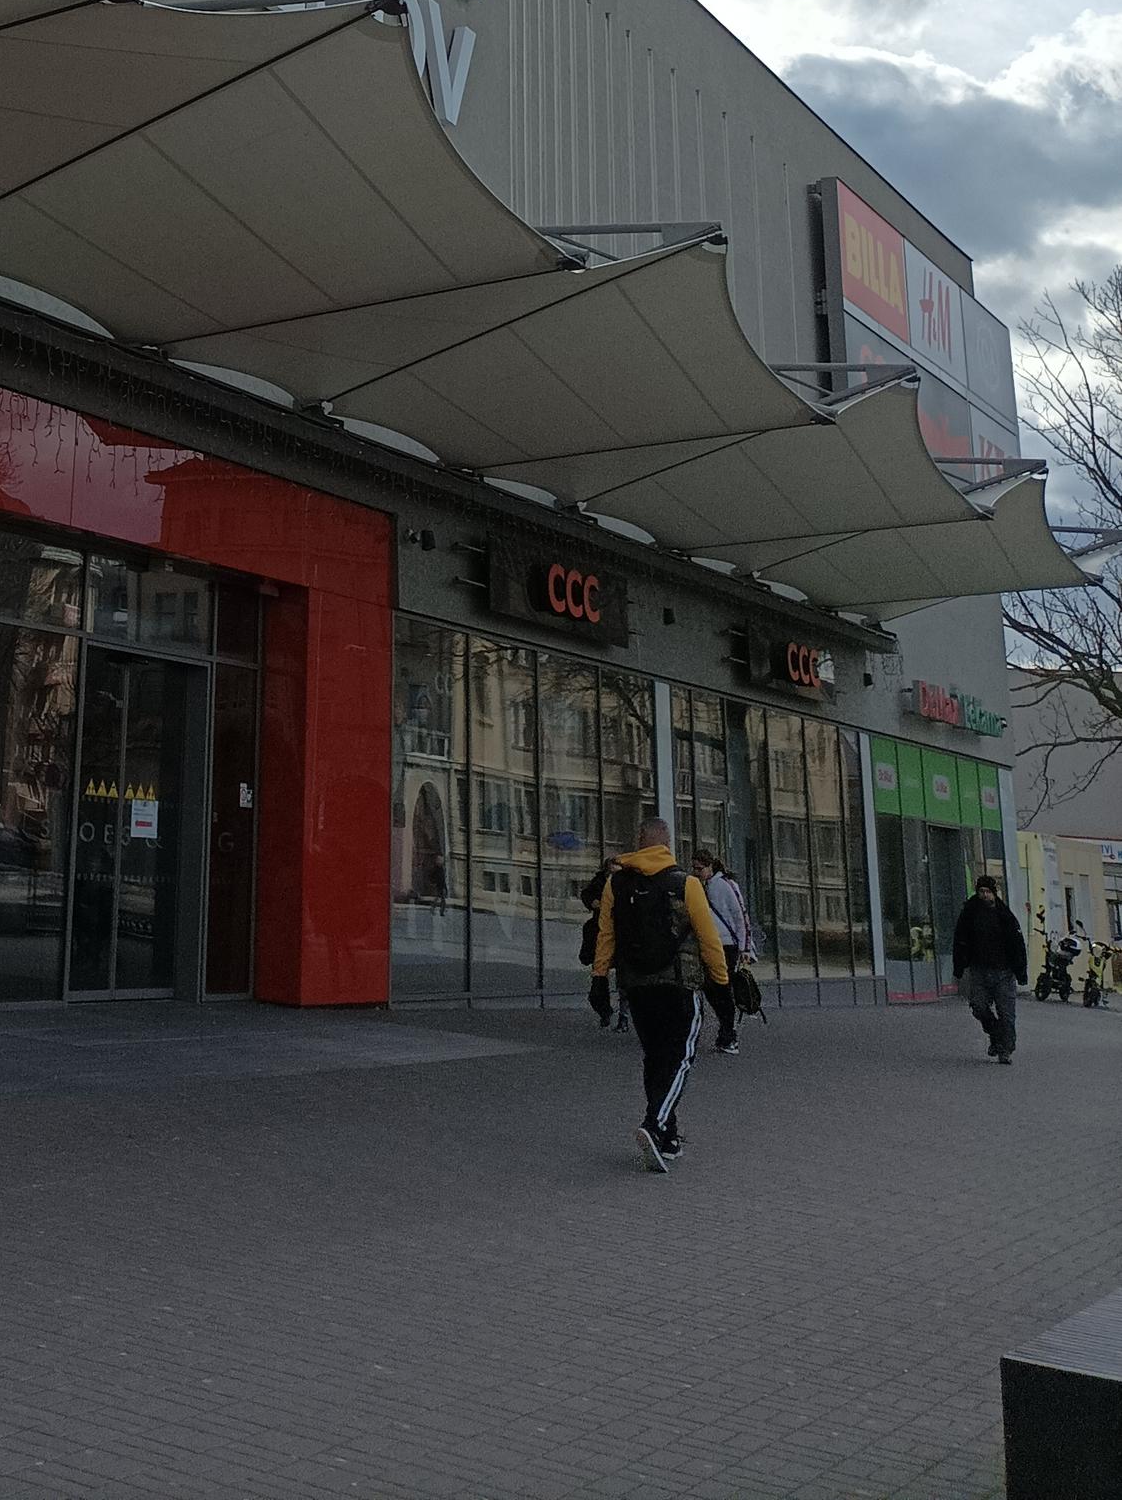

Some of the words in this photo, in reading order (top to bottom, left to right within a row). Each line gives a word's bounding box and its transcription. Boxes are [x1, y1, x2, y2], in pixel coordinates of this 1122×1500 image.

[844, 211, 905, 315] BILLA
[919, 266, 953, 365] H&M
[548, 563, 600, 623] CCC
[787, 642, 822, 688] CCC
